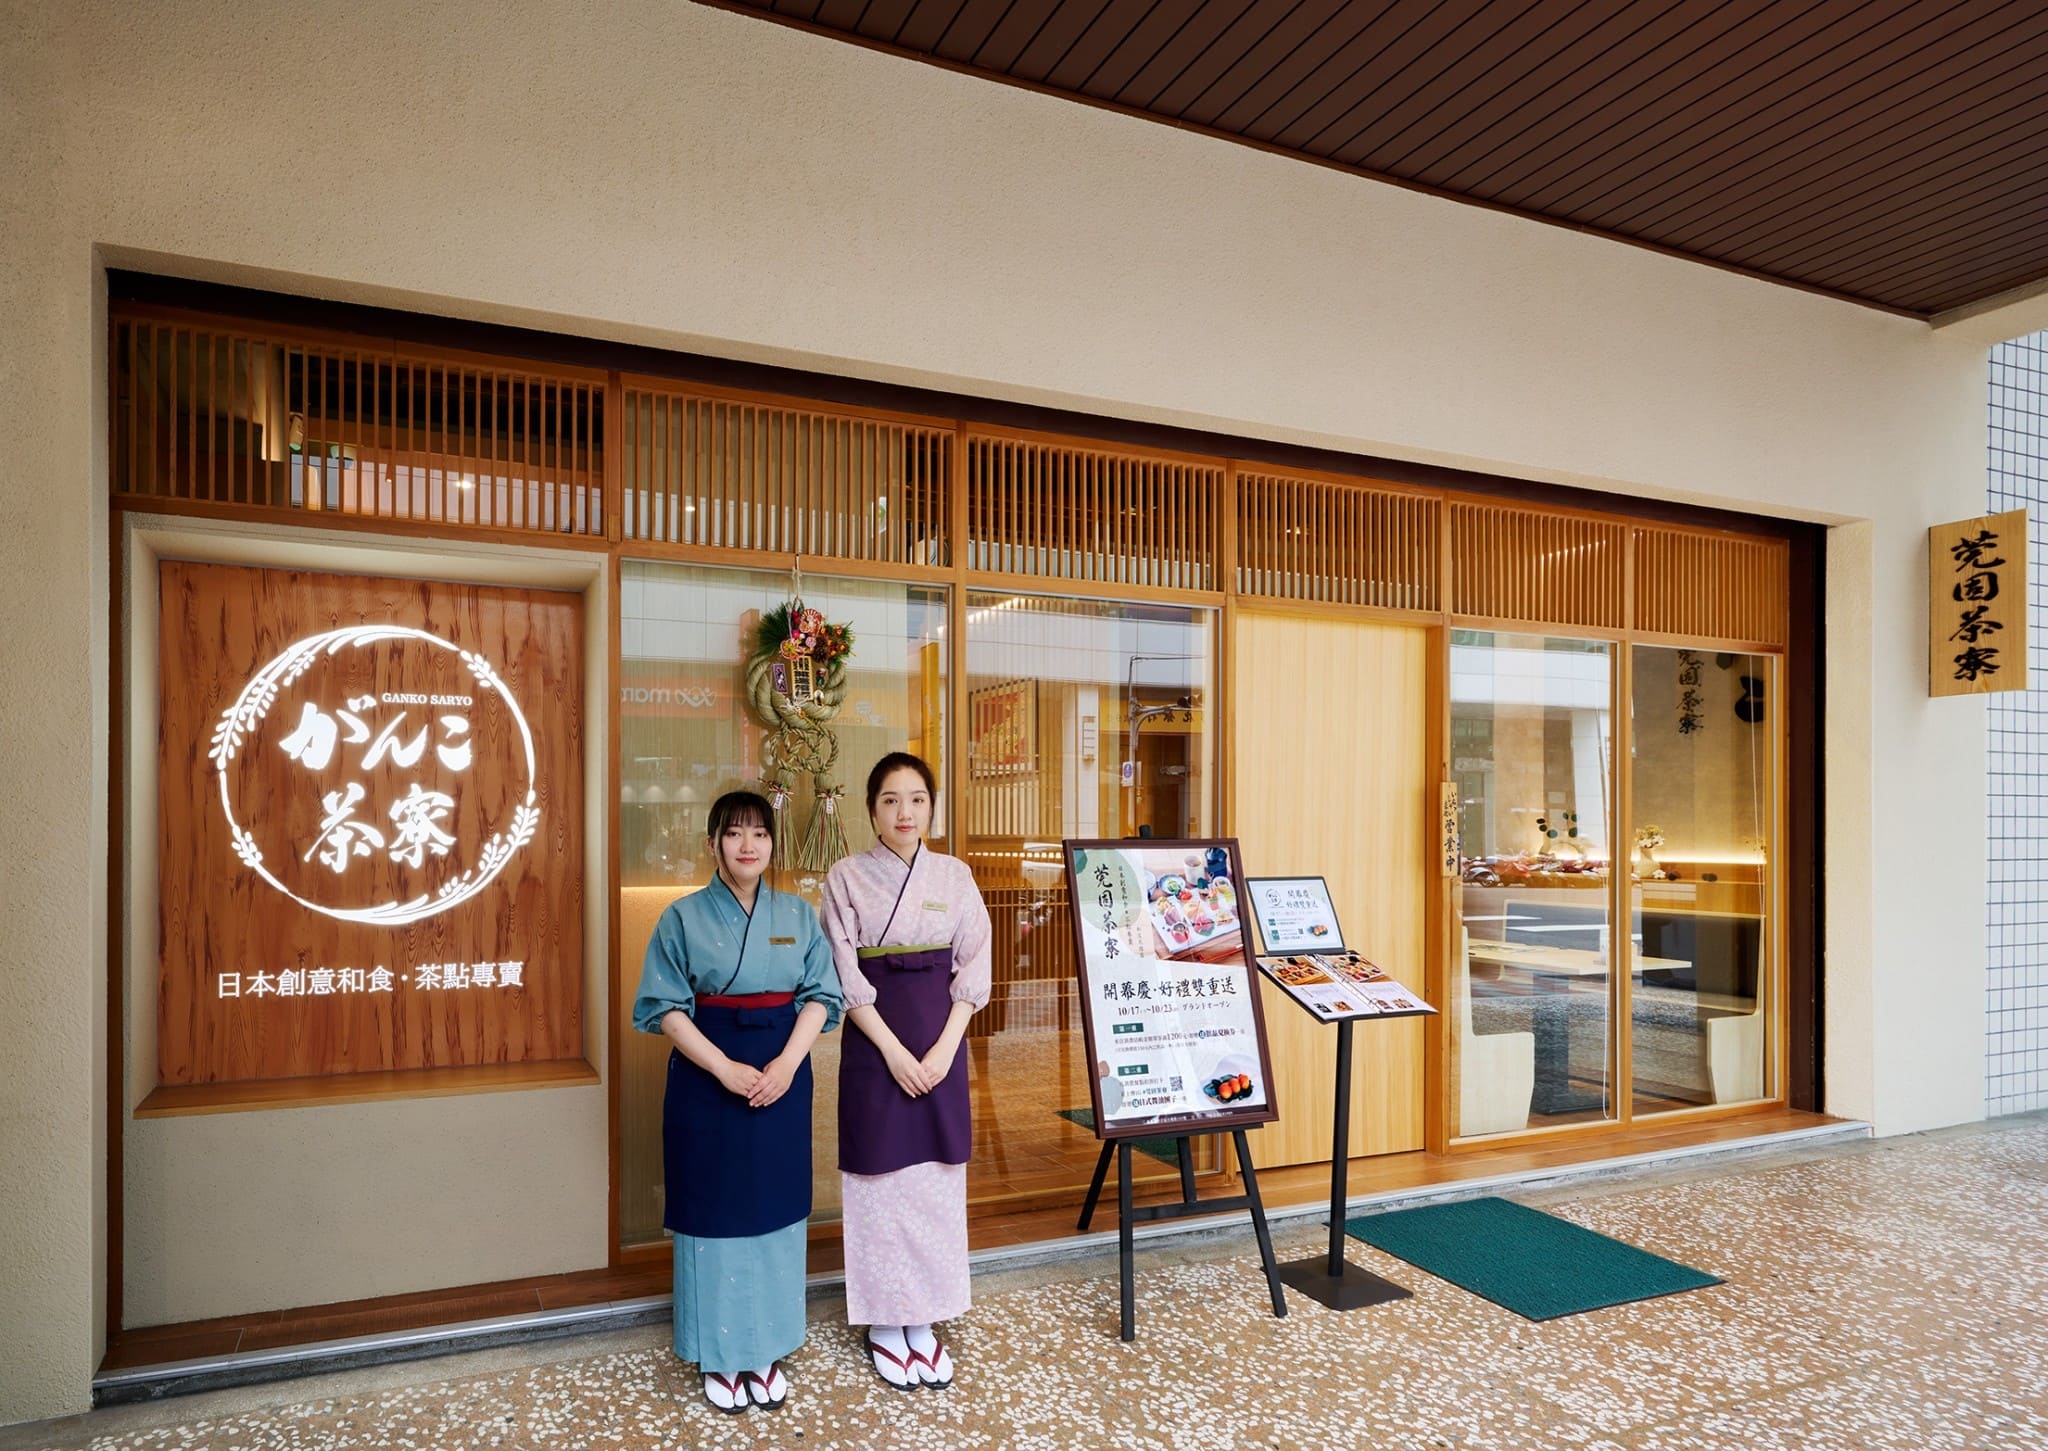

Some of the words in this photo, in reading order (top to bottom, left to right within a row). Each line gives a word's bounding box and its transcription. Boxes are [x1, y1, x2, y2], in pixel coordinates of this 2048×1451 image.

[279, 695, 474, 771] がんこ
[382, 692, 427, 705] GANKO
[430, 694, 473, 706] SARYO
[304, 782, 457, 873] 茶寮
